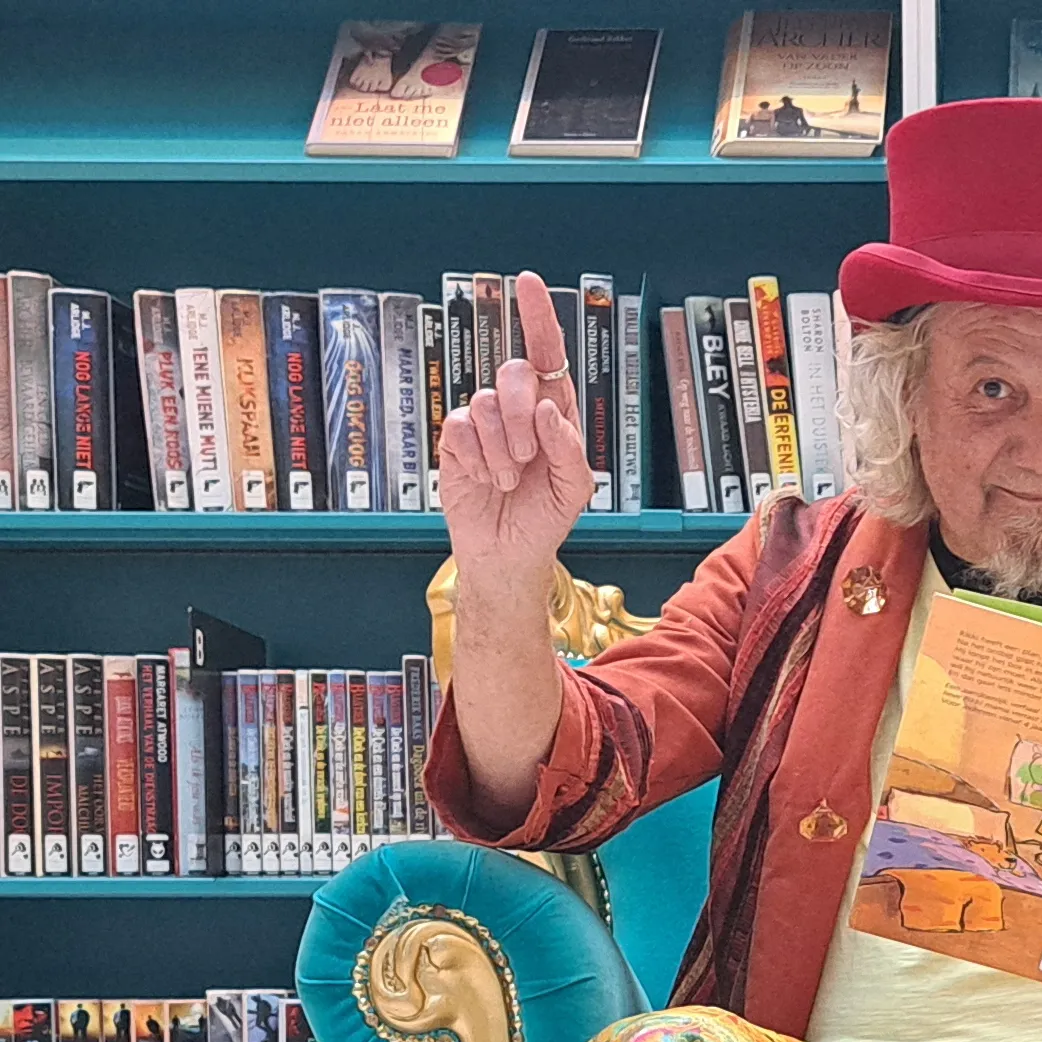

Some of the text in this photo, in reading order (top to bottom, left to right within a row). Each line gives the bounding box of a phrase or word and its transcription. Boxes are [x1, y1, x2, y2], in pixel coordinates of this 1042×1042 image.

[805, 62, 853, 71] ZOON
[330, 114, 450, 129] niet alleen
[356, 101, 408, 113] Laat
[451, 316, 463, 385] INDRIDASON
[479, 315, 491, 385] INDRIDASON
[587, 315, 599, 385] INDRIDASON
[800, 309, 812, 352] BOLTON
[812, 308, 825, 353] SHARON
[429, 360, 441, 388] TWEE
[702, 334, 731, 400] BLEY
[75, 351, 95, 471] NOG LANGE NIET
[157, 351, 184, 470] PLUK EEN ROOS
[195, 385, 214, 431] MIENE
[287, 352, 307, 471] NOG LANGE NIET
[626, 403, 640, 428] Het
[770, 388, 788, 410] DE
[810, 385, 824, 411] HET
[2, 661, 20, 736] ASPE
[39, 661, 56, 735] ASPE
[74, 661, 92, 736] ASPE
[156, 665, 169, 763] MARGARET ATWOOD
[415, 807, 427, 820] de
